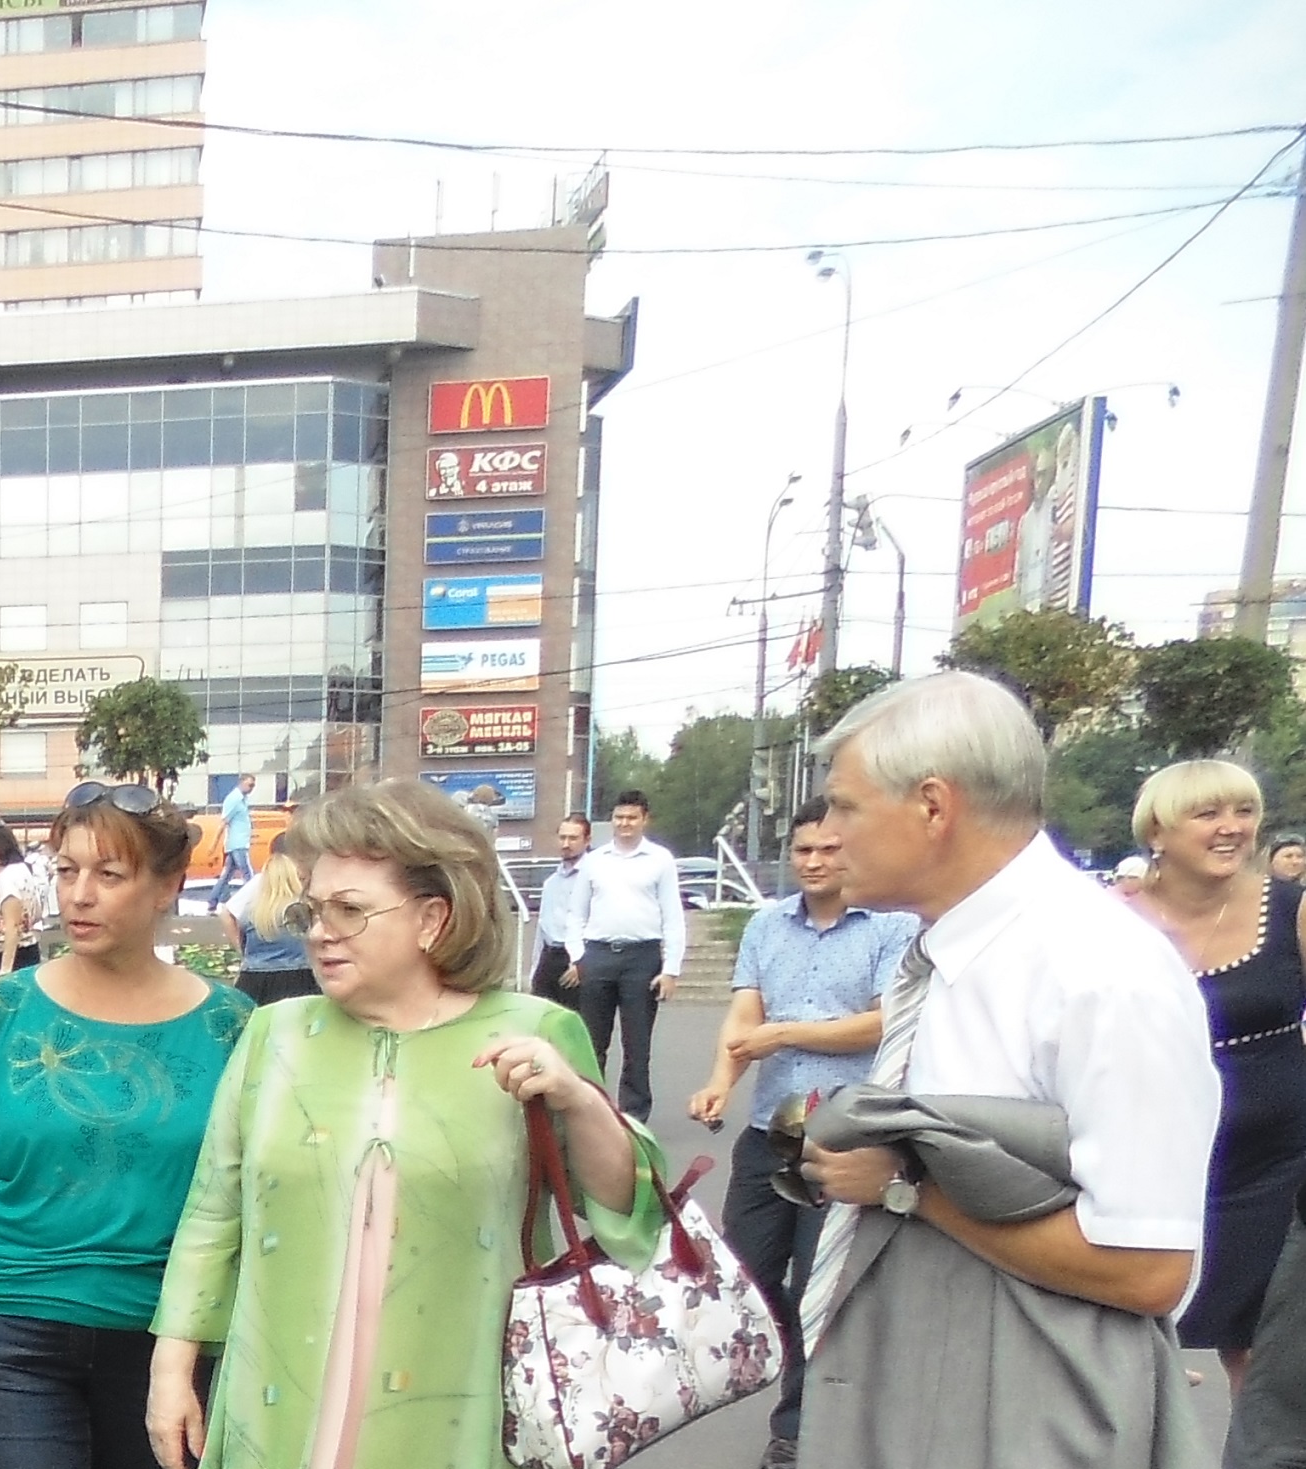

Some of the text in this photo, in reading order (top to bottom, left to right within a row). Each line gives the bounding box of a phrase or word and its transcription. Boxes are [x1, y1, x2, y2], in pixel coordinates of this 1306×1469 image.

[469, 450, 542, 473] КФС
[475, 480, 533, 493] 4 этаж
[481, 652, 526, 667] PEGAS
[469, 711, 533, 725] МЯГКАЯ
[469, 724, 532, 738] МЕБЕЛЬ
